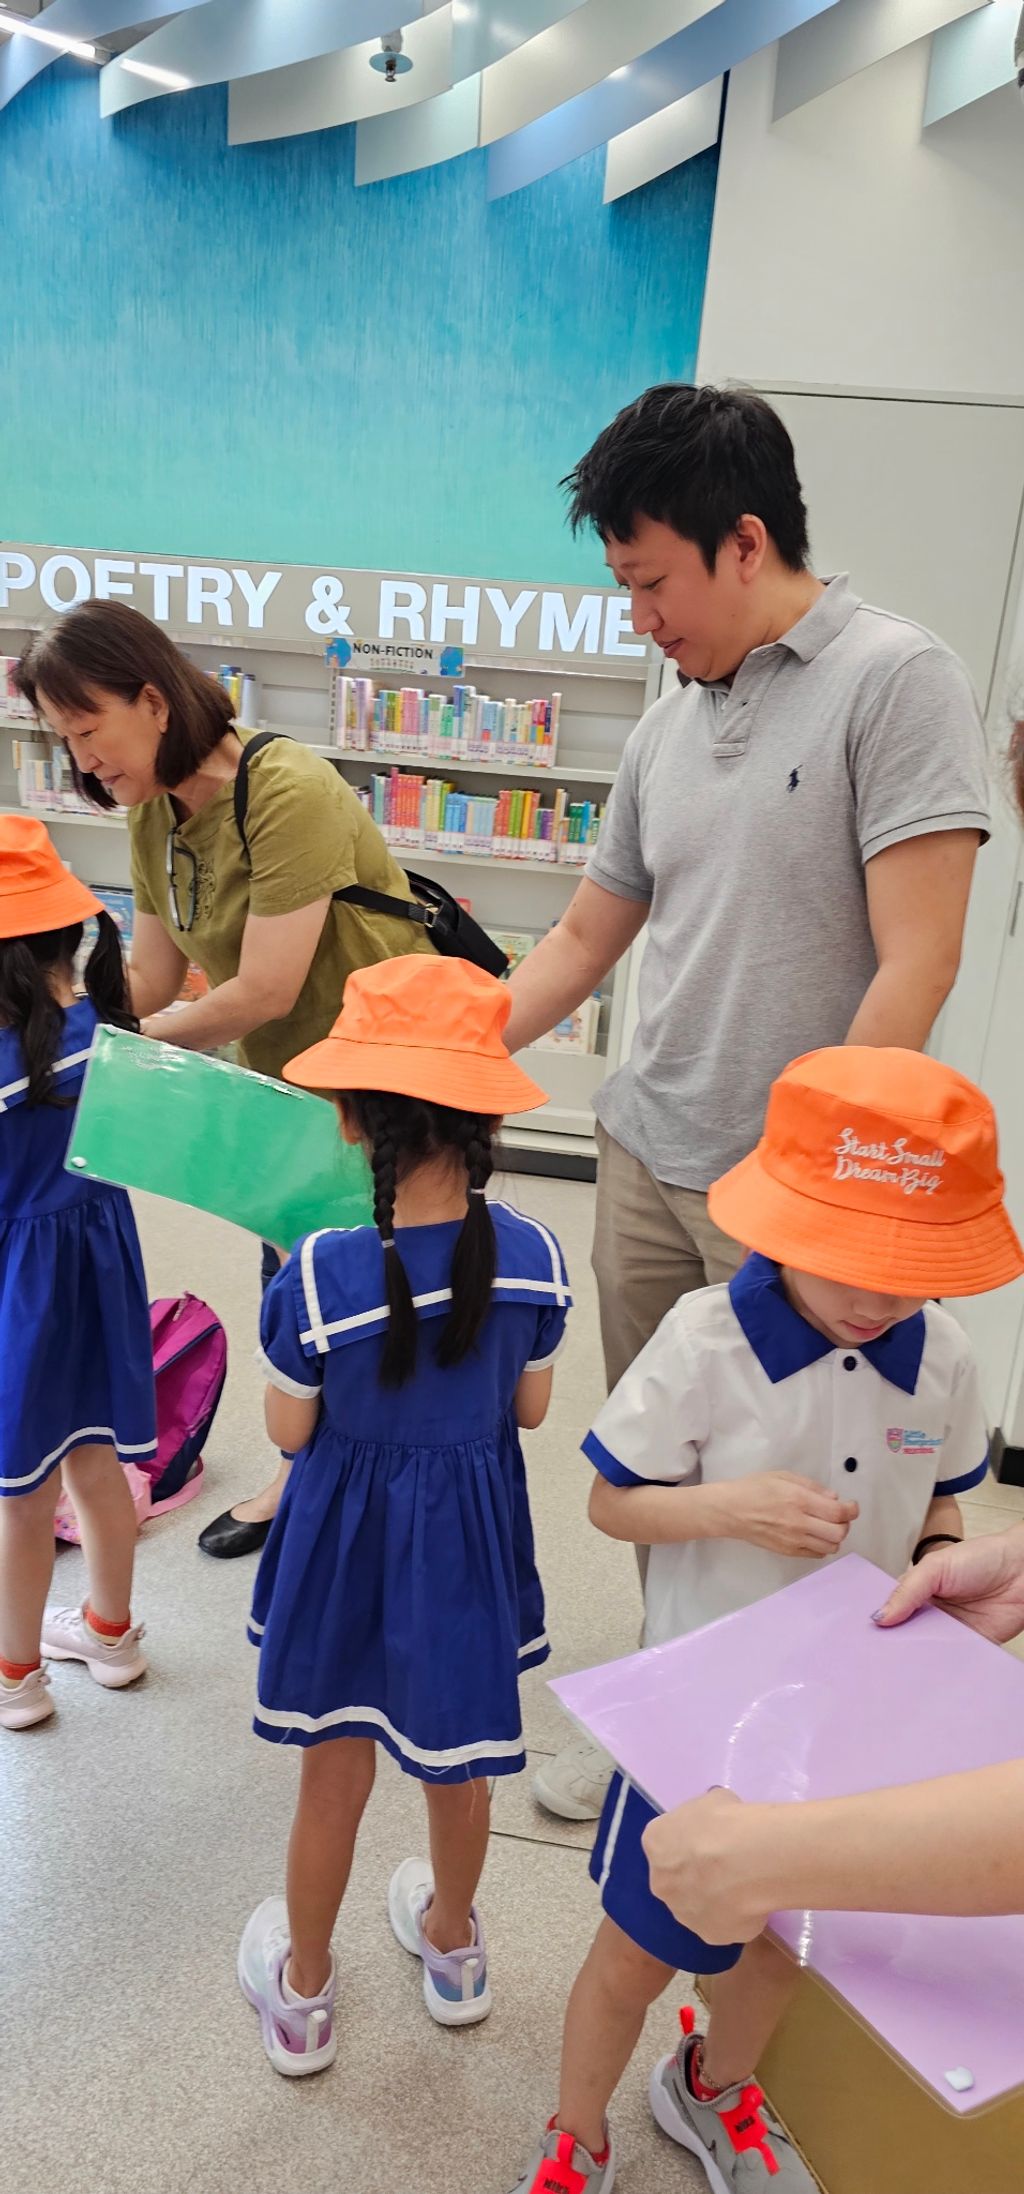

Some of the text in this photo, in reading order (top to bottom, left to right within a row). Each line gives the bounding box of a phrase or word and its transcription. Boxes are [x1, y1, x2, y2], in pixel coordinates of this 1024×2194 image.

[0, 551, 647, 657] POETRY & RHYME
[352, 642, 434, 660] NON-FICTION
[834, 1127, 945, 1167] Start Small
[832, 1154, 944, 1195] Dream Big
